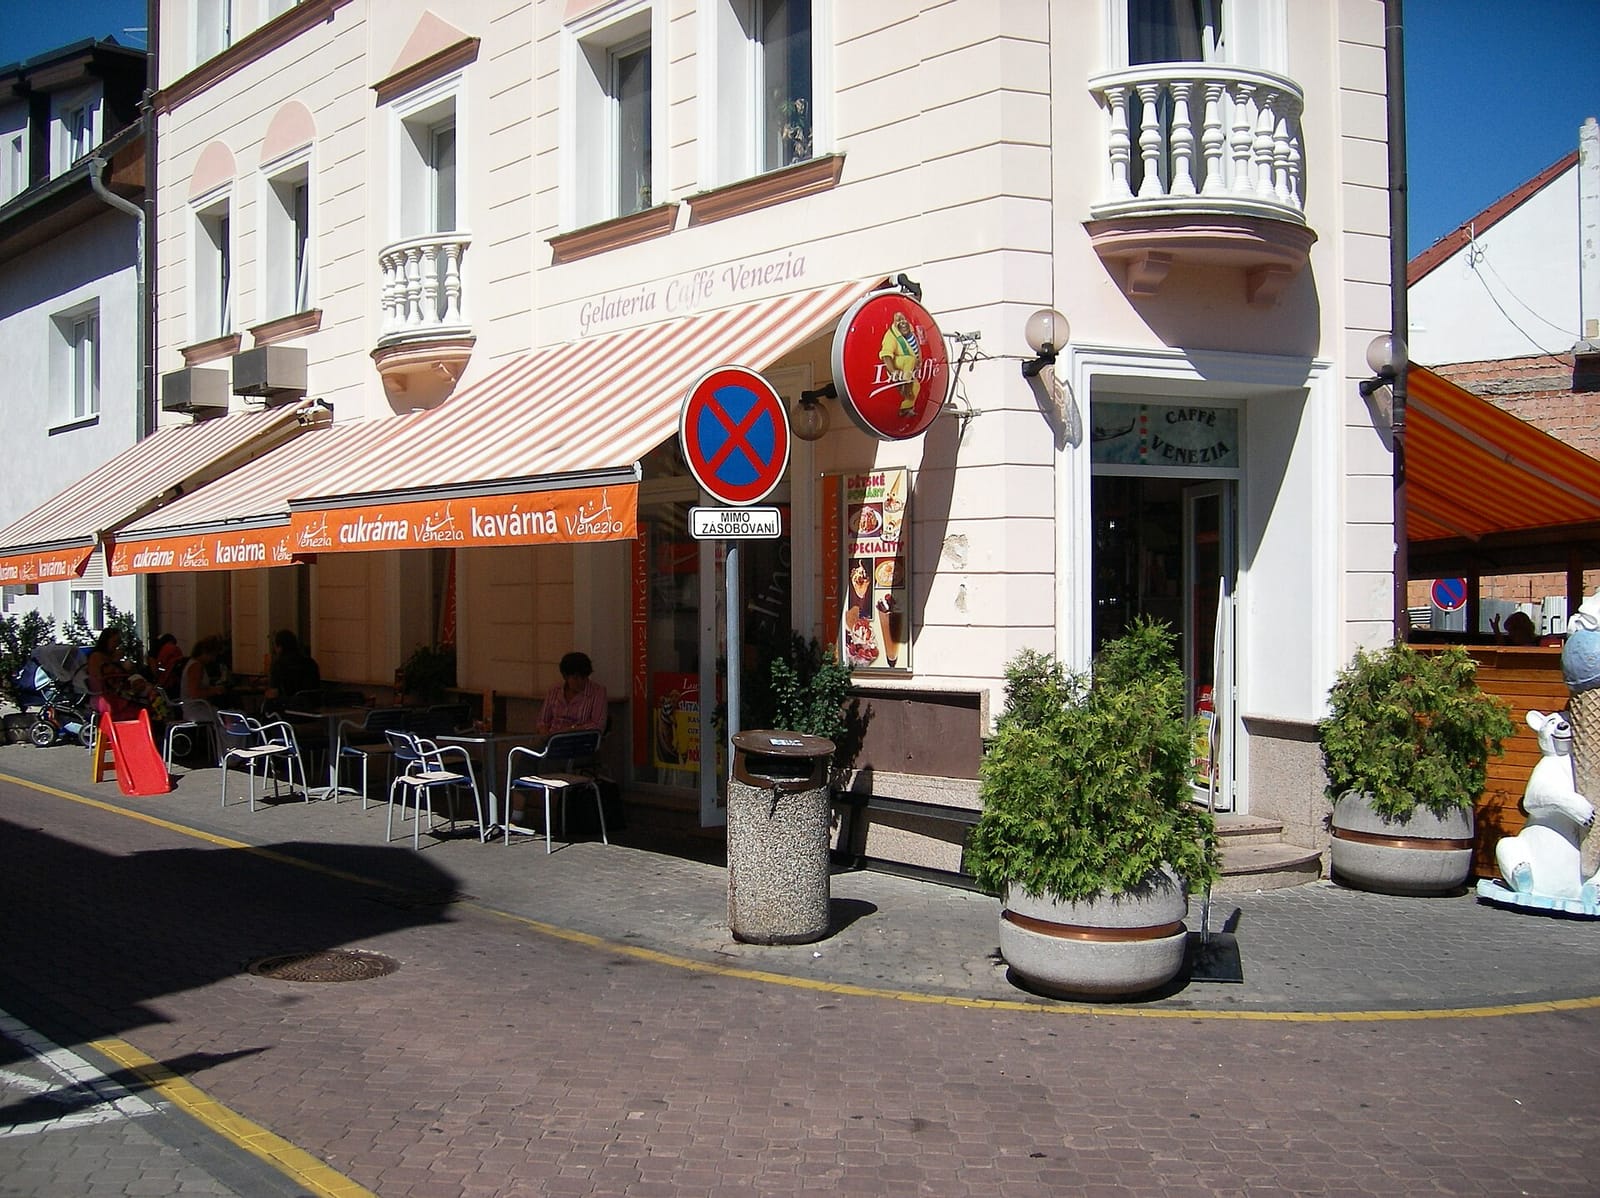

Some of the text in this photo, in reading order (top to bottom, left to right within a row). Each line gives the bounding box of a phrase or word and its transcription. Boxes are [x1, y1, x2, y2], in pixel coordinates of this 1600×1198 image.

[580, 288, 656, 337] Gelateria
[722, 251, 806, 292] Venezia
[1151, 434, 1231, 463] VENEZIA
[339, 513, 409, 544] cukrárna
[412, 522, 465, 543] Venezia
[470, 502, 558, 538] kavárna
[565, 513, 624, 536] Venezia
[720, 512, 751, 523] MIMO
[133, 546, 175, 568] cukrárna
[215, 538, 266, 564] kavárna
[271, 546, 293, 561] Vene
[848, 541, 905, 554] SPECIALITY
[39, 556, 67, 577] kavárna
